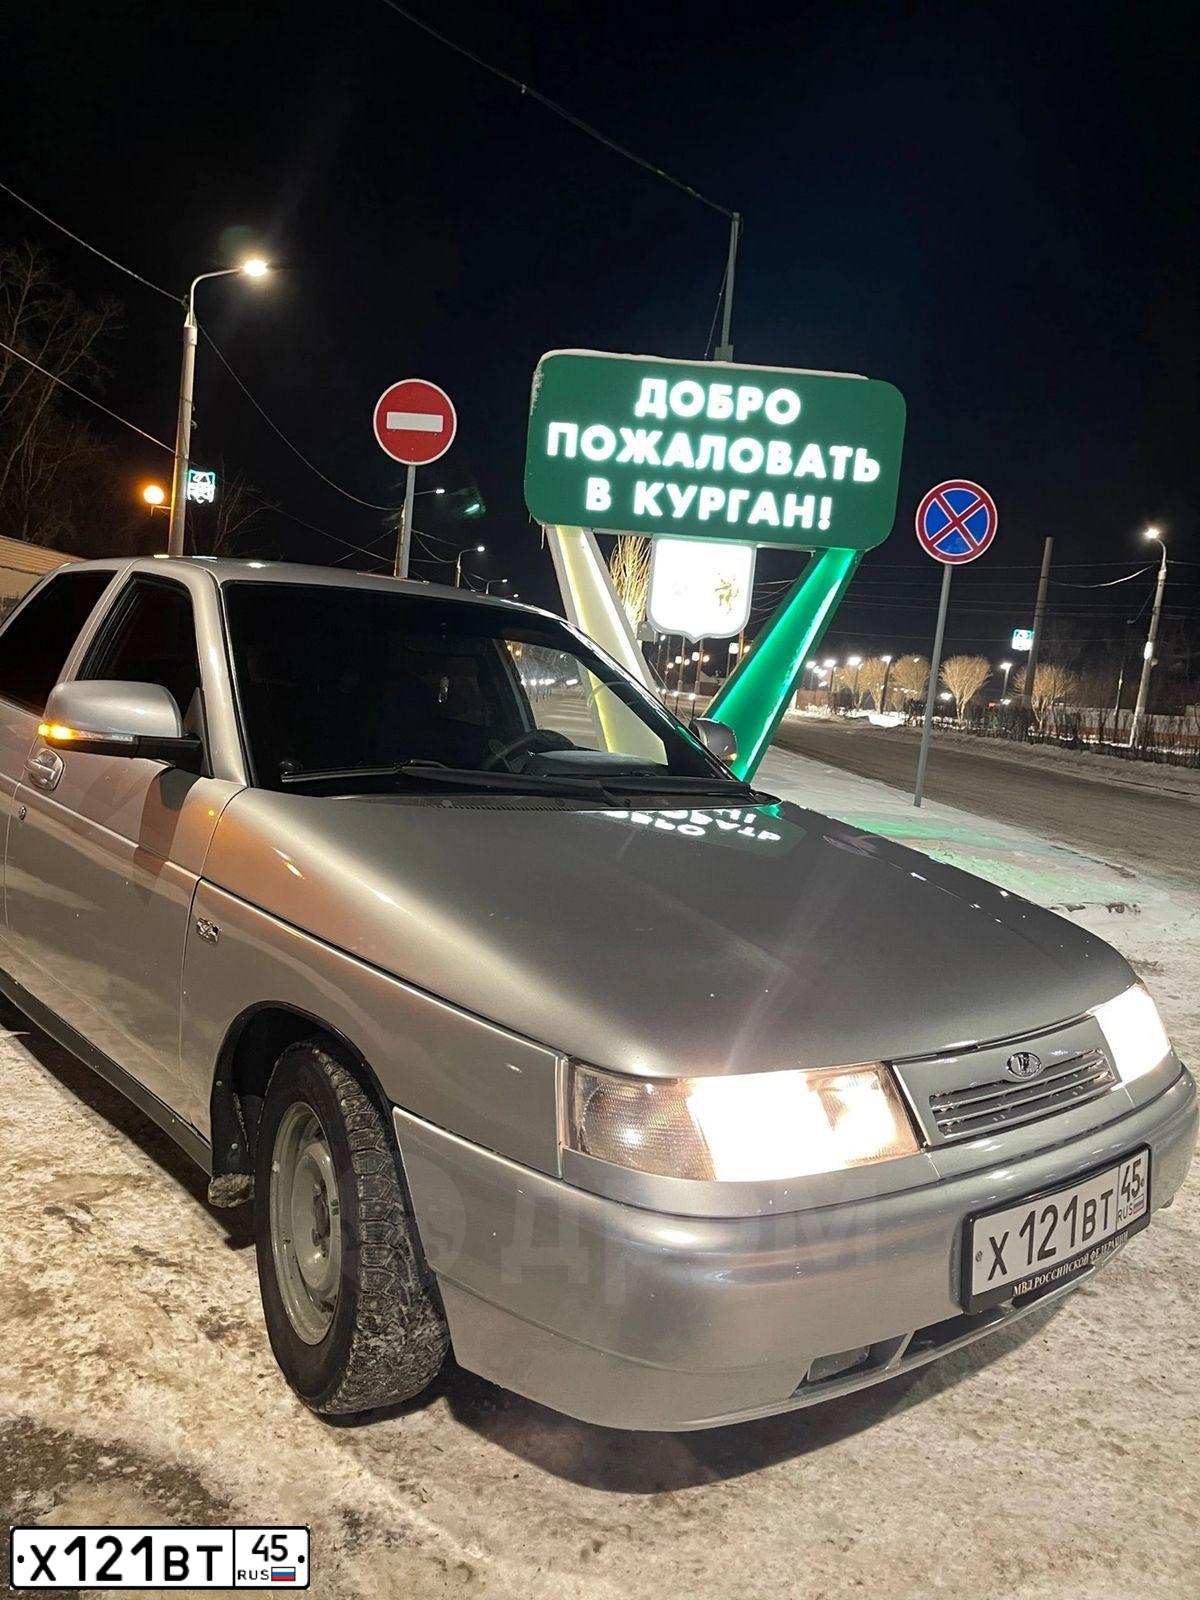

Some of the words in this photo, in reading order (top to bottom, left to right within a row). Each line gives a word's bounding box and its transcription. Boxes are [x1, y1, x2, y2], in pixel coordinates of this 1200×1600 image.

[634, 377, 801, 425] ДОБРО
[546, 421, 881, 483] ПОЖАЛОВАТЬ
[585, 476, 612, 512] В
[633, 481, 833, 531] КУРГАН!
[988, 1188, 1113, 1281] Х121ВТ
[1121, 1158, 1142, 1203] 45
[1117, 1202, 1133, 1223] RUS
